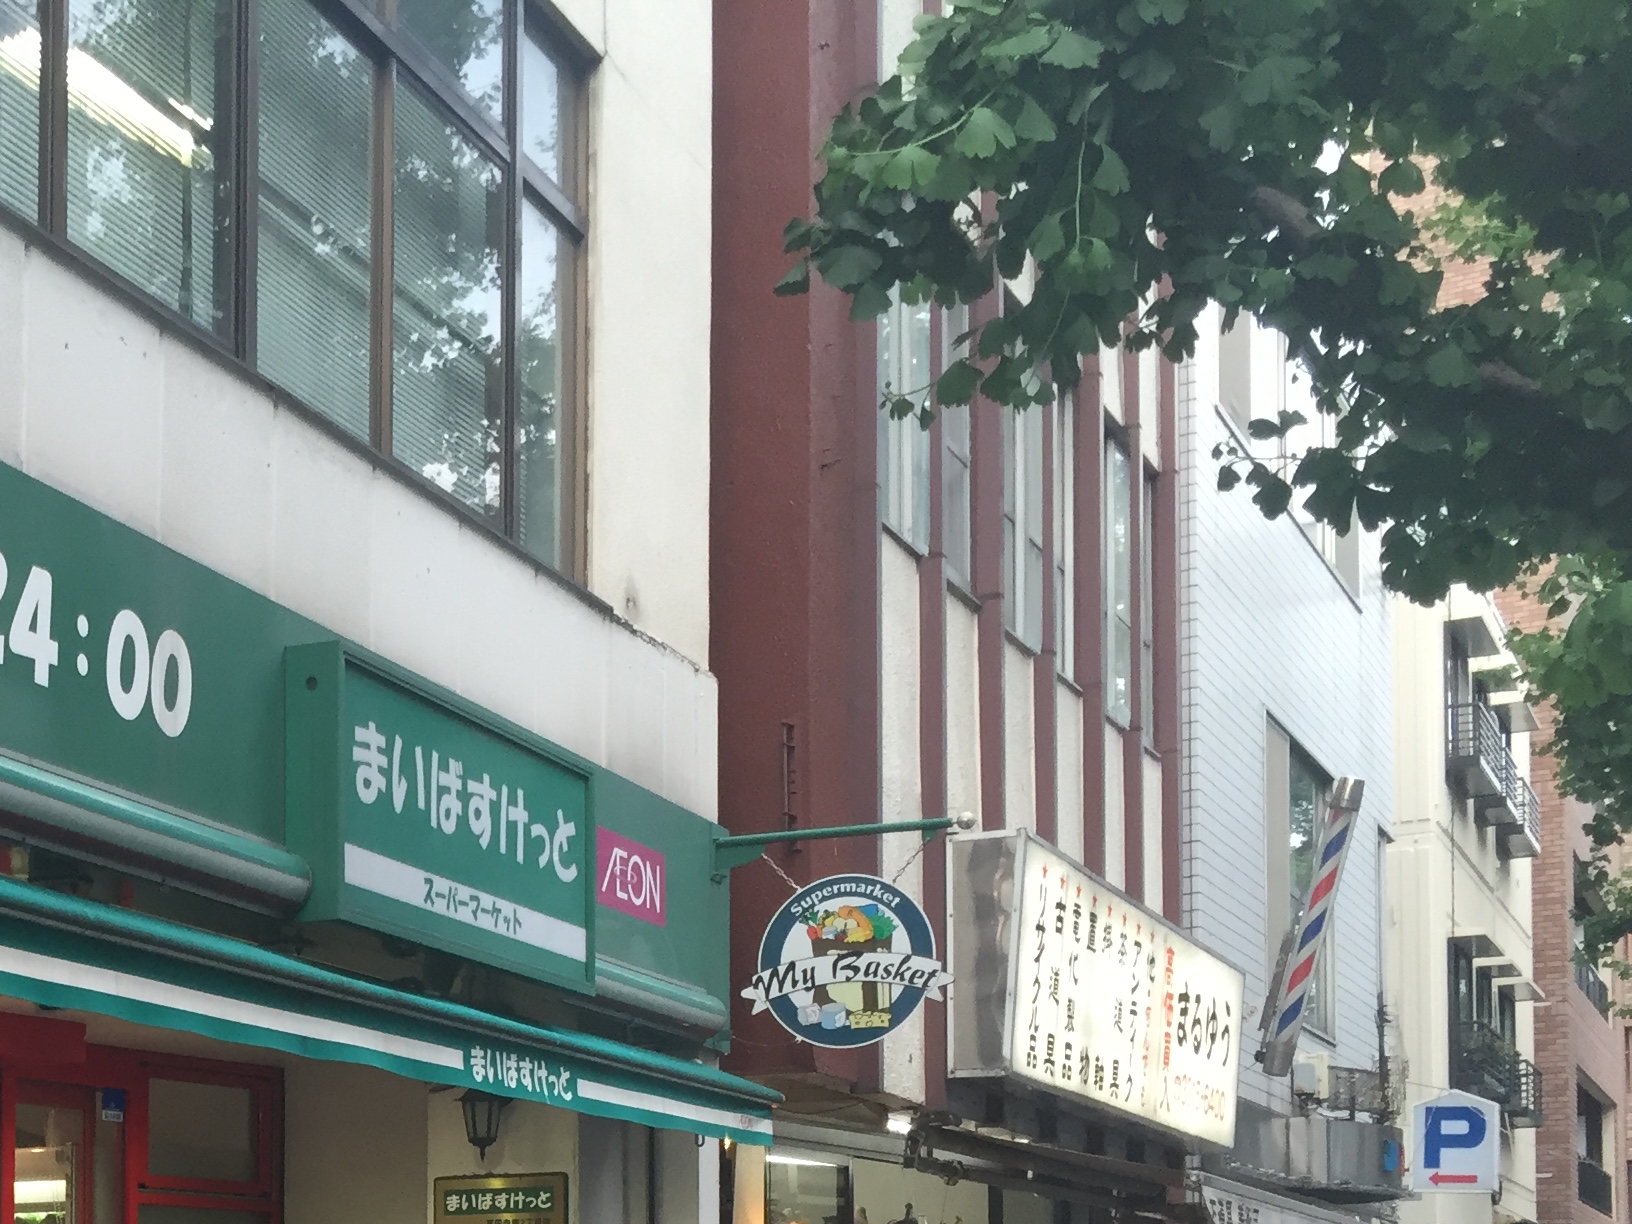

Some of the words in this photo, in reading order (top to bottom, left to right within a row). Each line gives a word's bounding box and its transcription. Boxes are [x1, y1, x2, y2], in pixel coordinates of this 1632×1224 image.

[352, 721, 579, 883] まいばすけっと
[423, 877, 522, 936] スーパーマーケット
[790, 881, 900, 917] Supermarket
[753, 961, 817, 996] My
[832, 951, 938, 989] Basket
[1027, 883, 1048, 1069] リサイクル品
[1044, 896, 1067, 1077] 古道具
[1124, 939, 1142, 1102] アンティーク
[1177, 981, 1232, 1067] まるゆう
[470, 1045, 573, 1102] まいばすけっと
[1424, 1106, 1487, 1169] P
[445, 1191, 552, 1212] まいばすけっと
